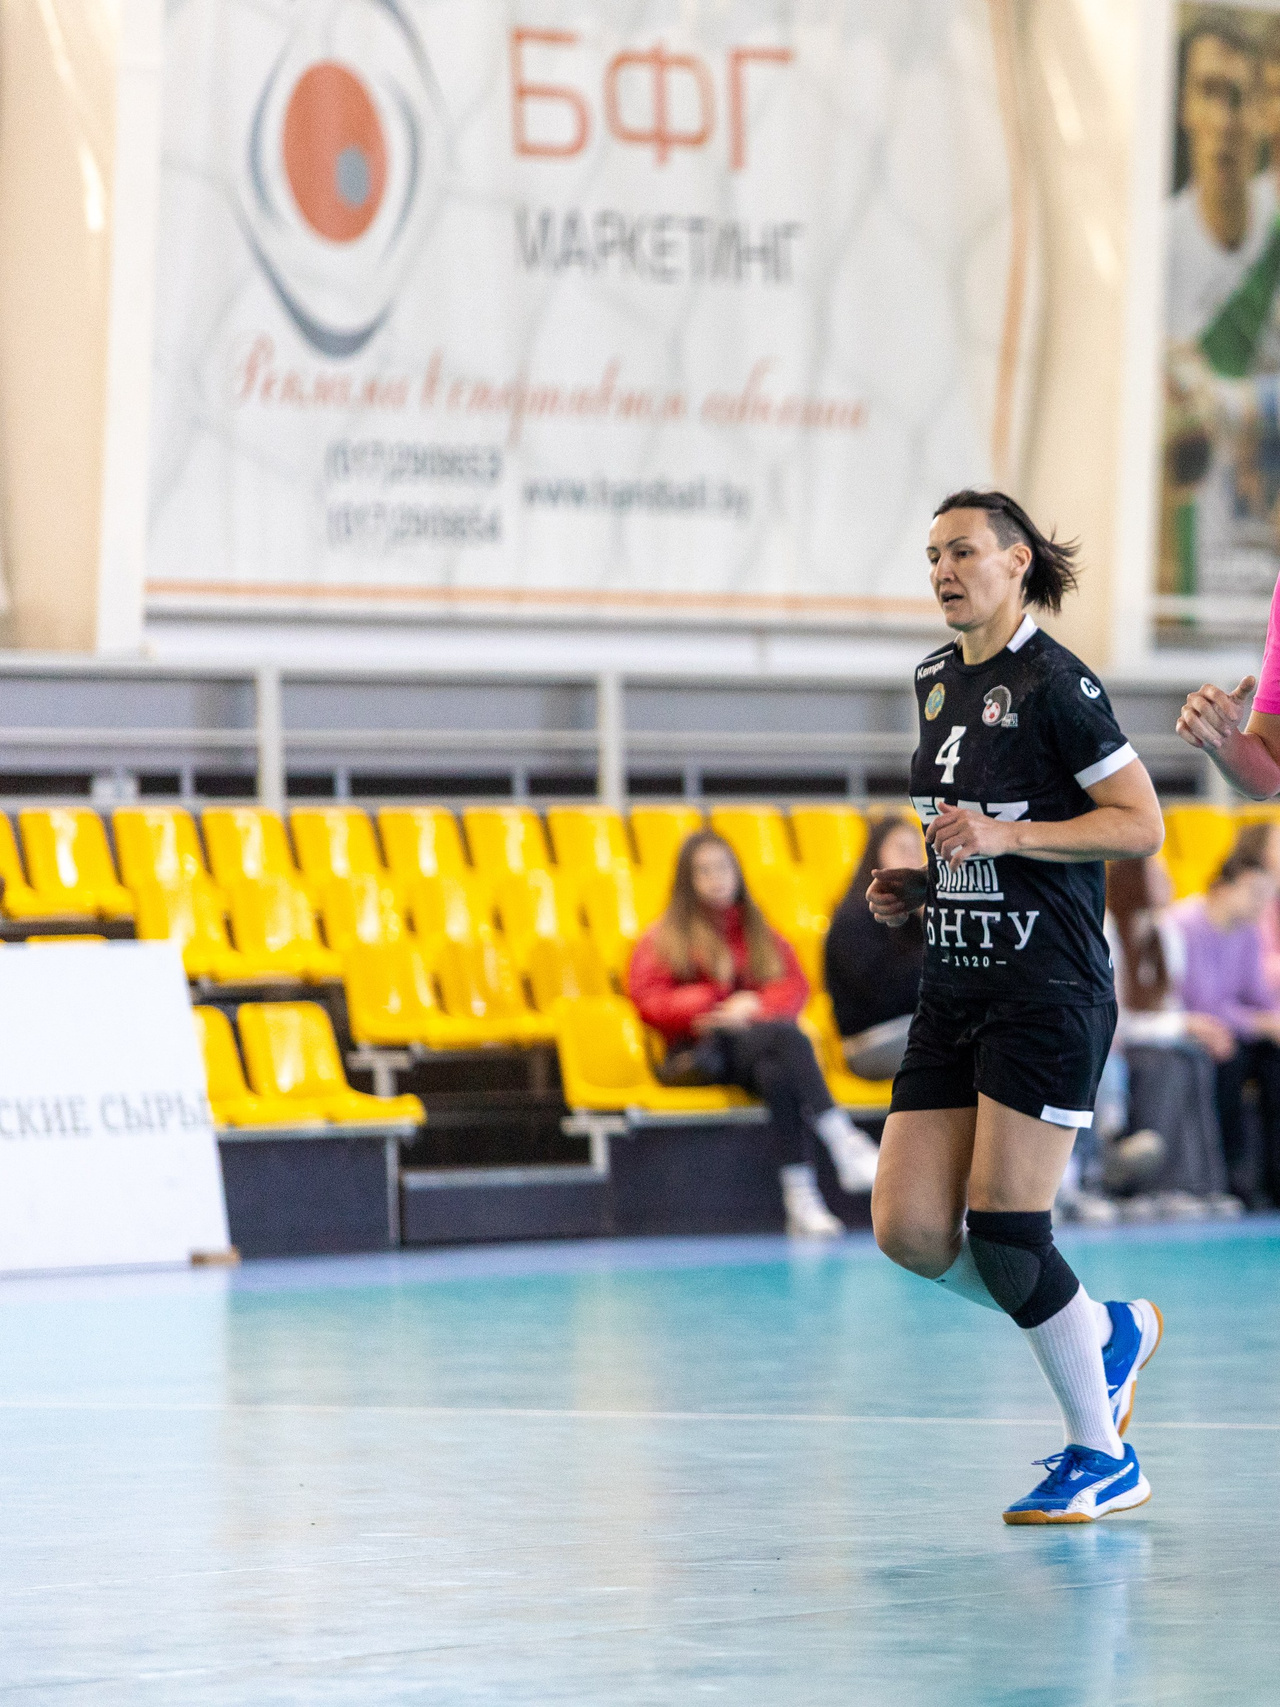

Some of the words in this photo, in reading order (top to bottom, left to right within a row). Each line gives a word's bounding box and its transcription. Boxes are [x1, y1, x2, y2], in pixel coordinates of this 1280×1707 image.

[511, 25, 795, 171] БФГ
[917, 660, 945, 680] Kempa
[935, 726, 966, 783] 4
[954, 955, 990, 967] 1920
